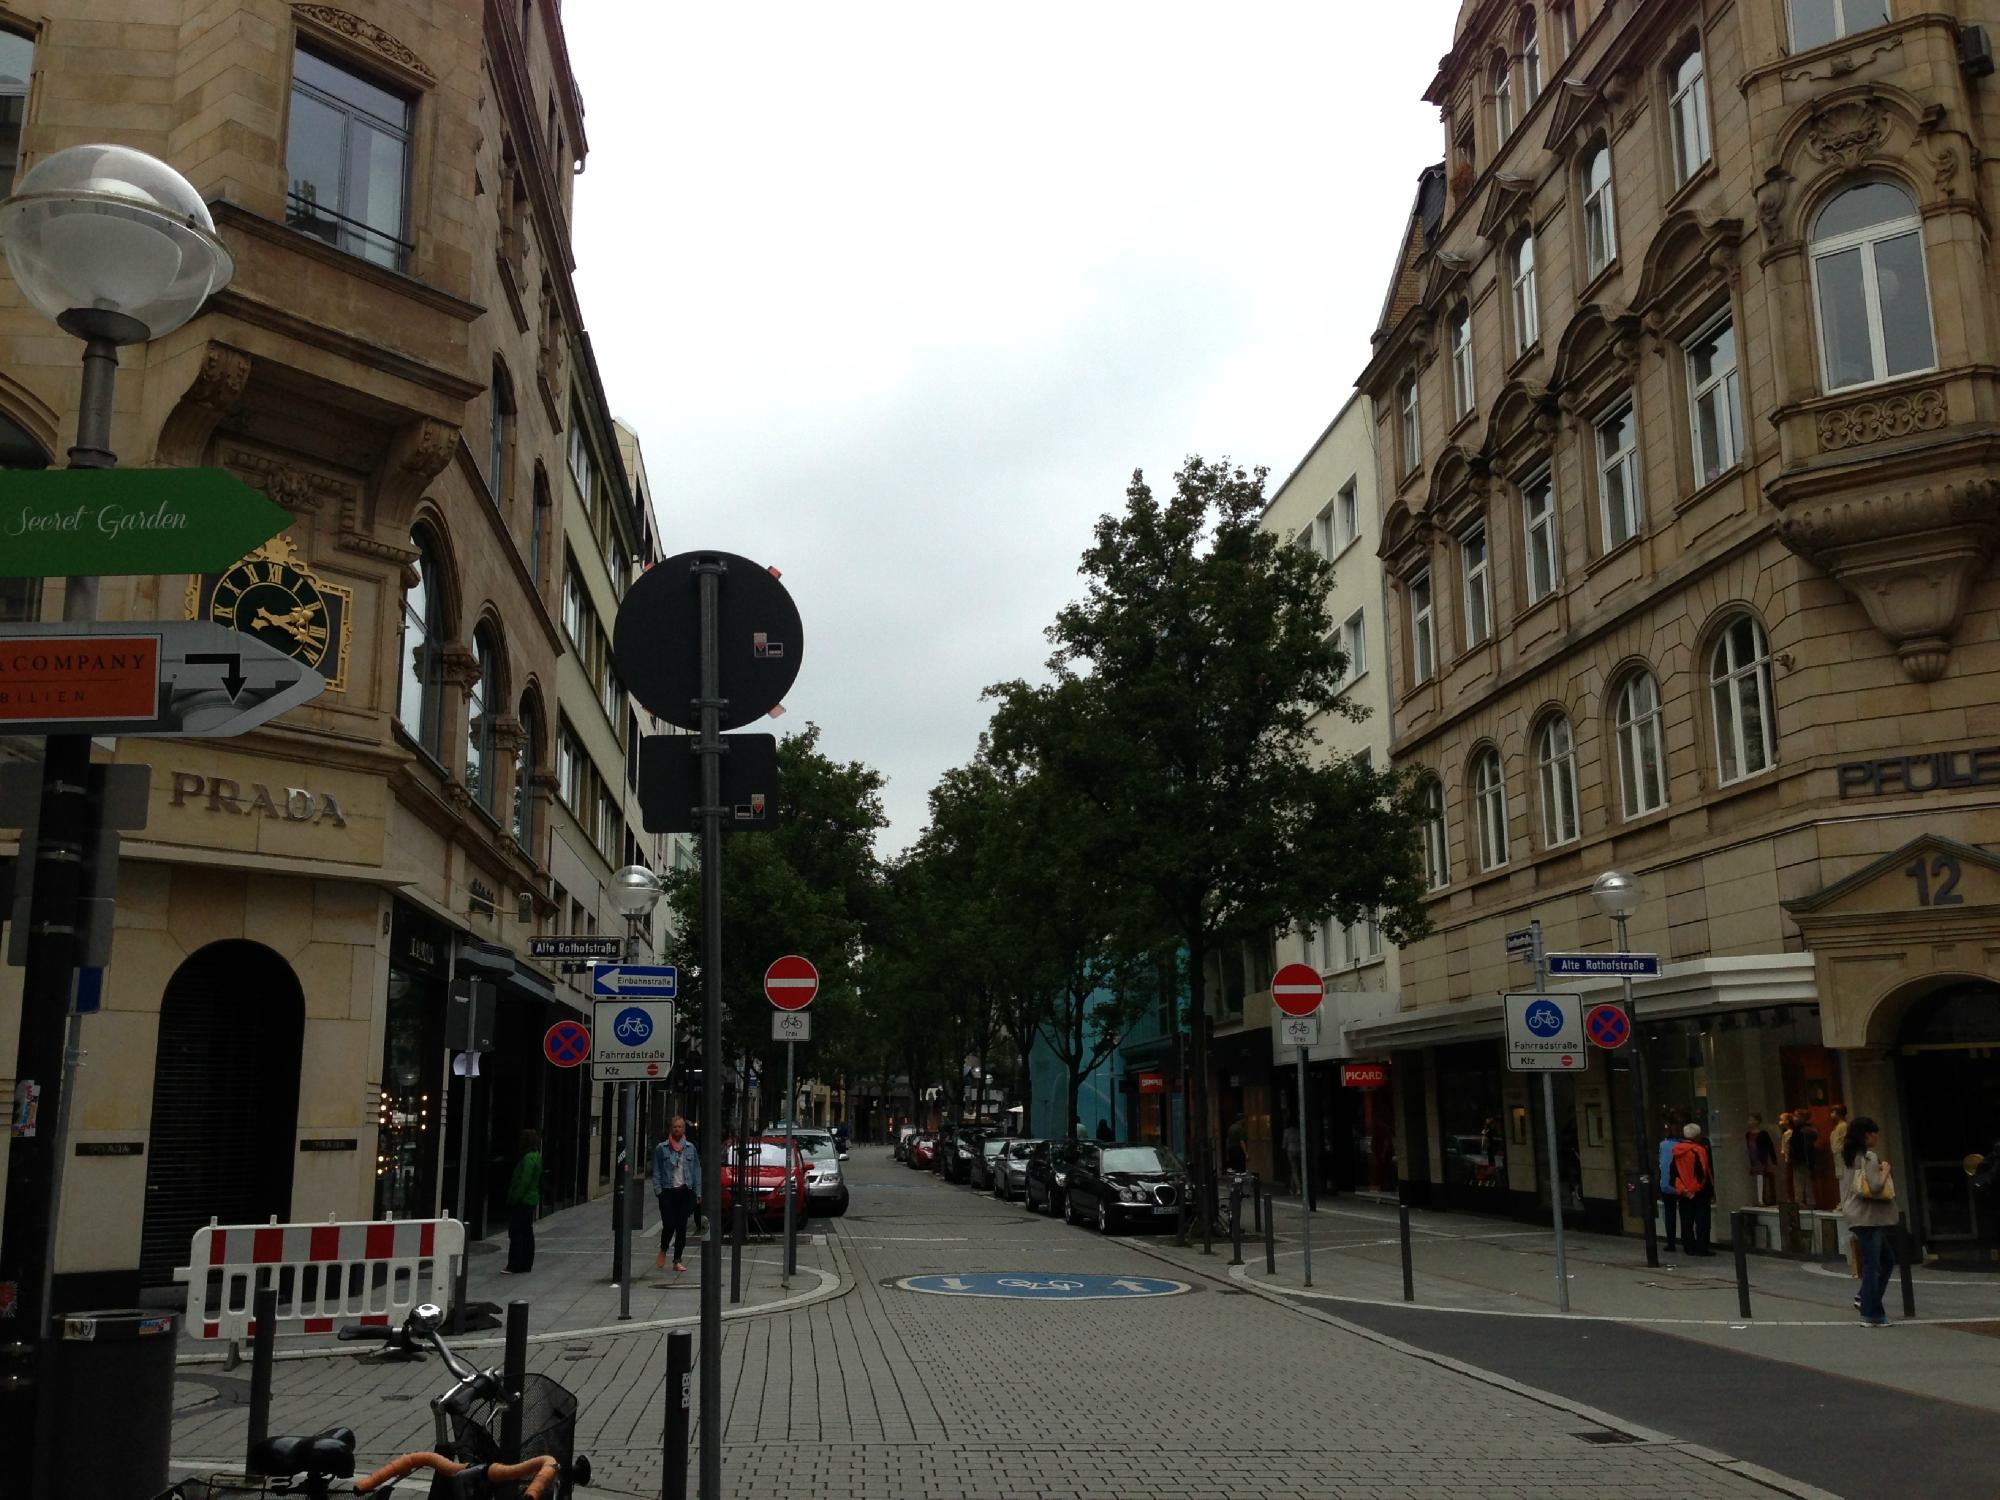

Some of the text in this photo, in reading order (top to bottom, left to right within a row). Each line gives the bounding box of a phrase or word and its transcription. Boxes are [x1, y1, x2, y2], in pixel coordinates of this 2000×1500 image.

[4, 500, 189, 541] Secret Garden
[12, 653, 146, 672] COMPANY
[167, 771, 348, 828] PRADA
[1905, 853, 1965, 907] 12
[536, 941, 618, 955] Alte Rothofstraße
[1561, 960, 1645, 971] Alte Rothofstraße
[617, 976, 672, 986] Einbahnstraße
[1514, 1041, 1578, 1050] Fahrradstraße
[600, 1050, 665, 1059] Fahrradstraße
[1520, 1057, 1536, 1065] Kfz
[605, 1066, 620, 1075] Kfz
[1345, 1071, 1383, 1080] PICARD
